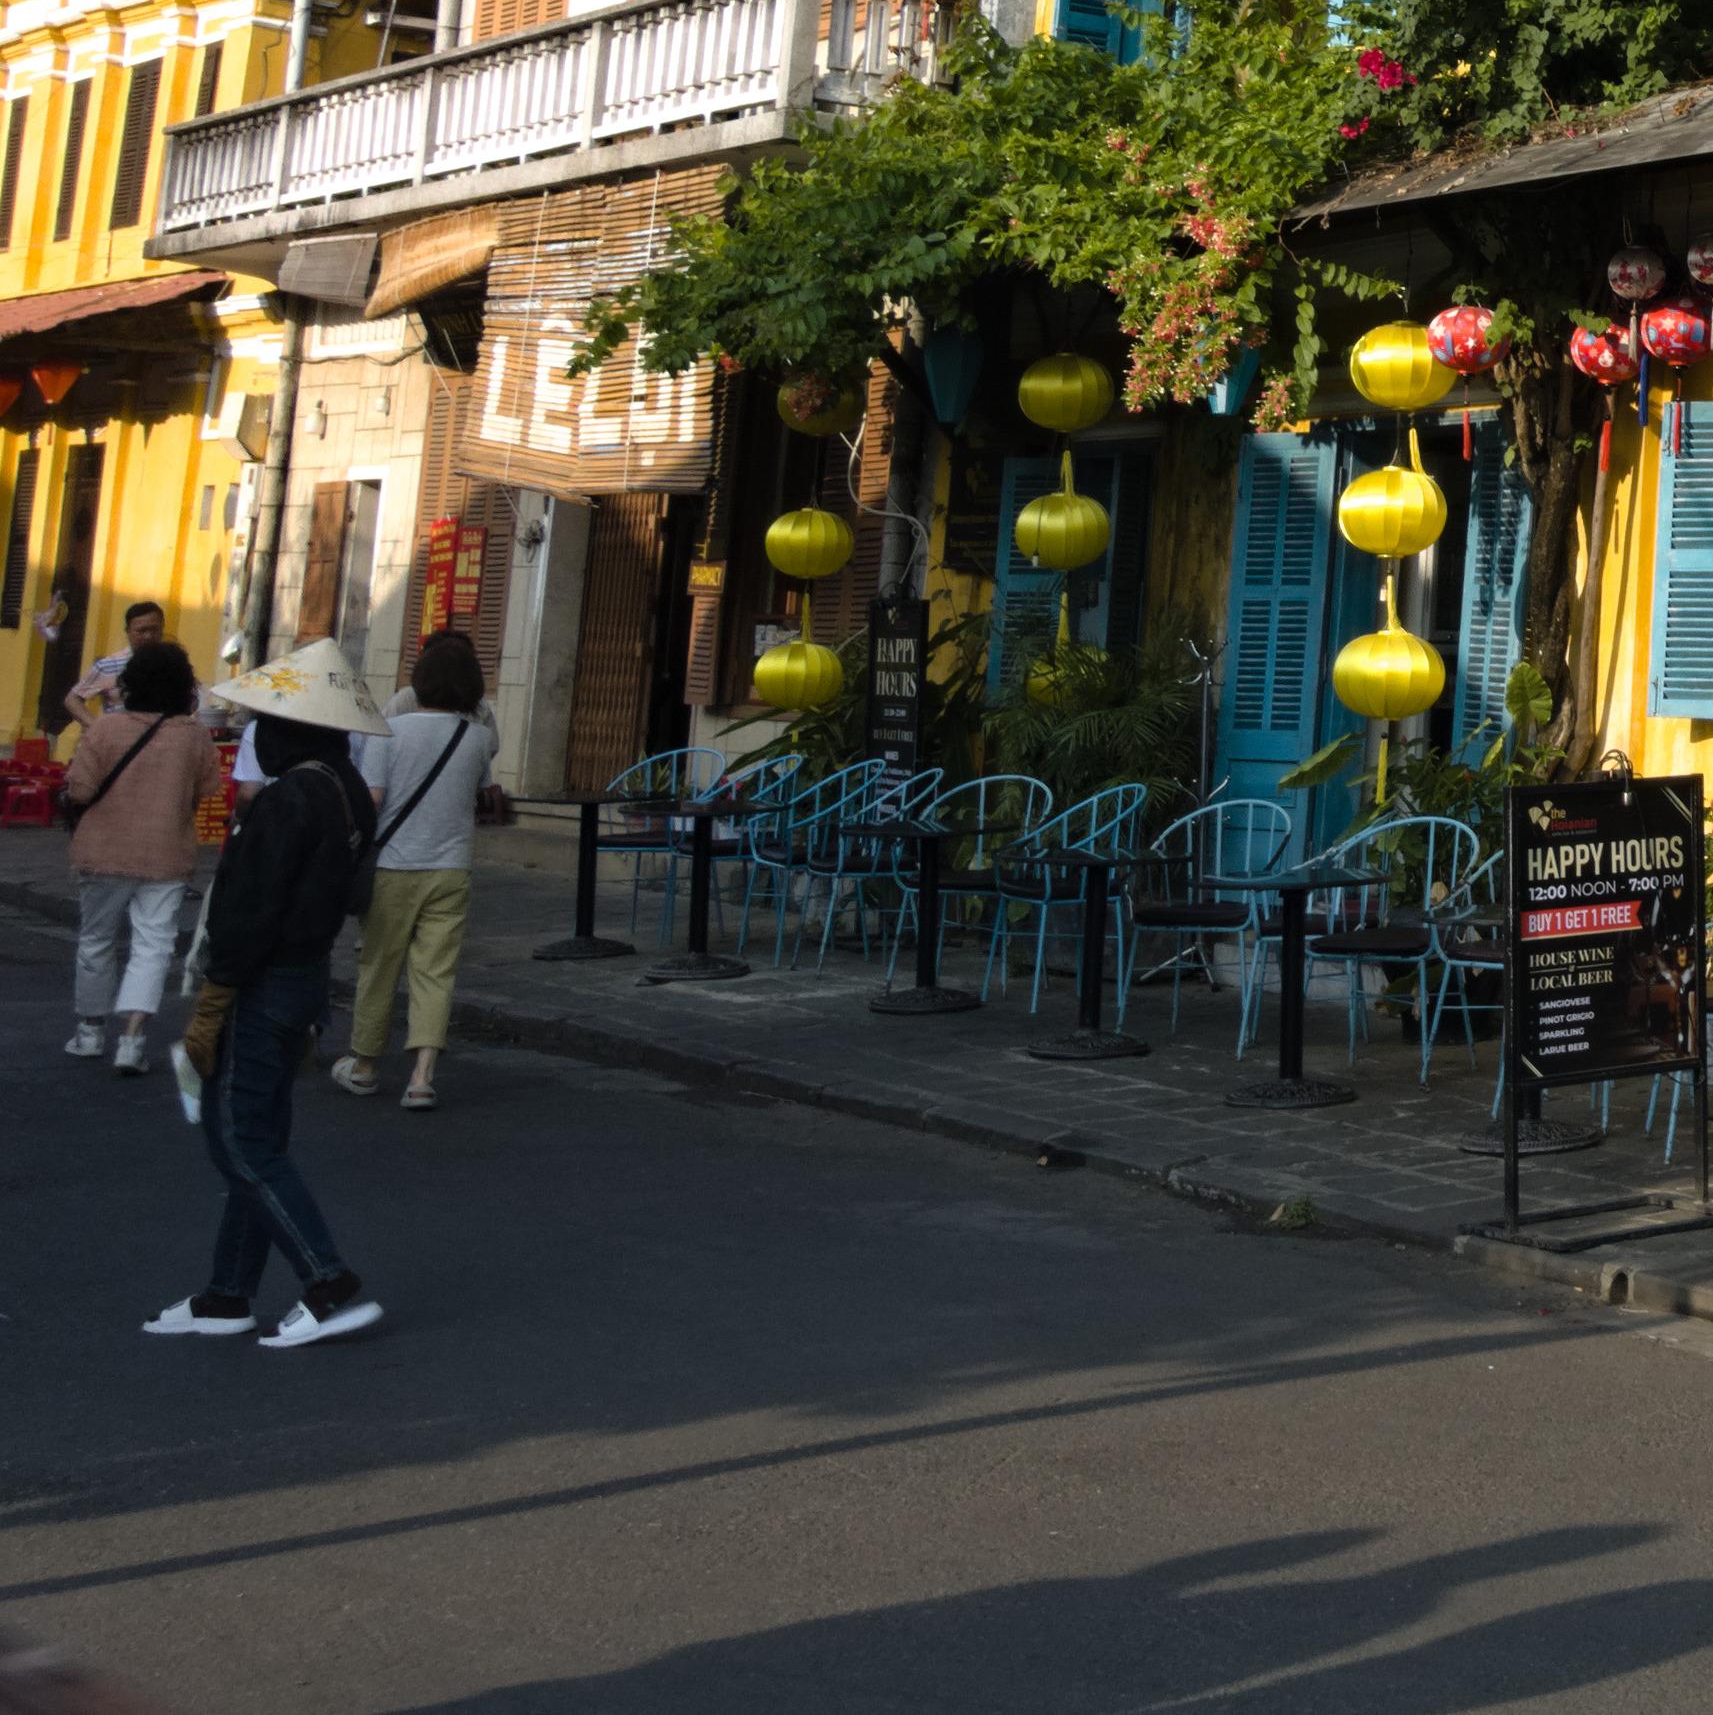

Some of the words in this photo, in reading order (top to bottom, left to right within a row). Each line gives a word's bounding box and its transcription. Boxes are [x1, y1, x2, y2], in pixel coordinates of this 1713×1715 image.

[480, 312, 577, 454] LÊ
[876, 637, 918, 664] HAPPY
[875, 670, 917, 697] HOURS
[1551, 807, 1567, 819] the
[1528, 842, 1605, 881] HAPPY
[1611, 835, 1684, 874] HOURS
[1529, 885, 1567, 902] 12:00
[1571, 880, 1617, 898] NOON
[1628, 876, 1659, 892] 7:00
[1663, 874, 1685, 888] PM
[1528, 912, 1552, 933] BUY
[1555, 911, 1562, 930] 1
[1565, 908, 1588, 929] GET
[1592, 907, 1598, 926] 1
[1601, 904, 1632, 926] FREE
[1529, 951, 1577, 968] HOUSE
[1578, 946, 1615, 962] WINE
[1530, 973, 1577, 991] LOCAL
[1578, 969, 1614, 986] BEER
[1539, 996, 1592, 1010] SANGIOVESE
[1539, 1014, 1565, 1025] PINOT
[1566, 1011, 1595, 1022] GRIGIO
[1539, 1027, 1586, 1041] SPARKLING
[1567, 1041, 1590, 1053] BEER
